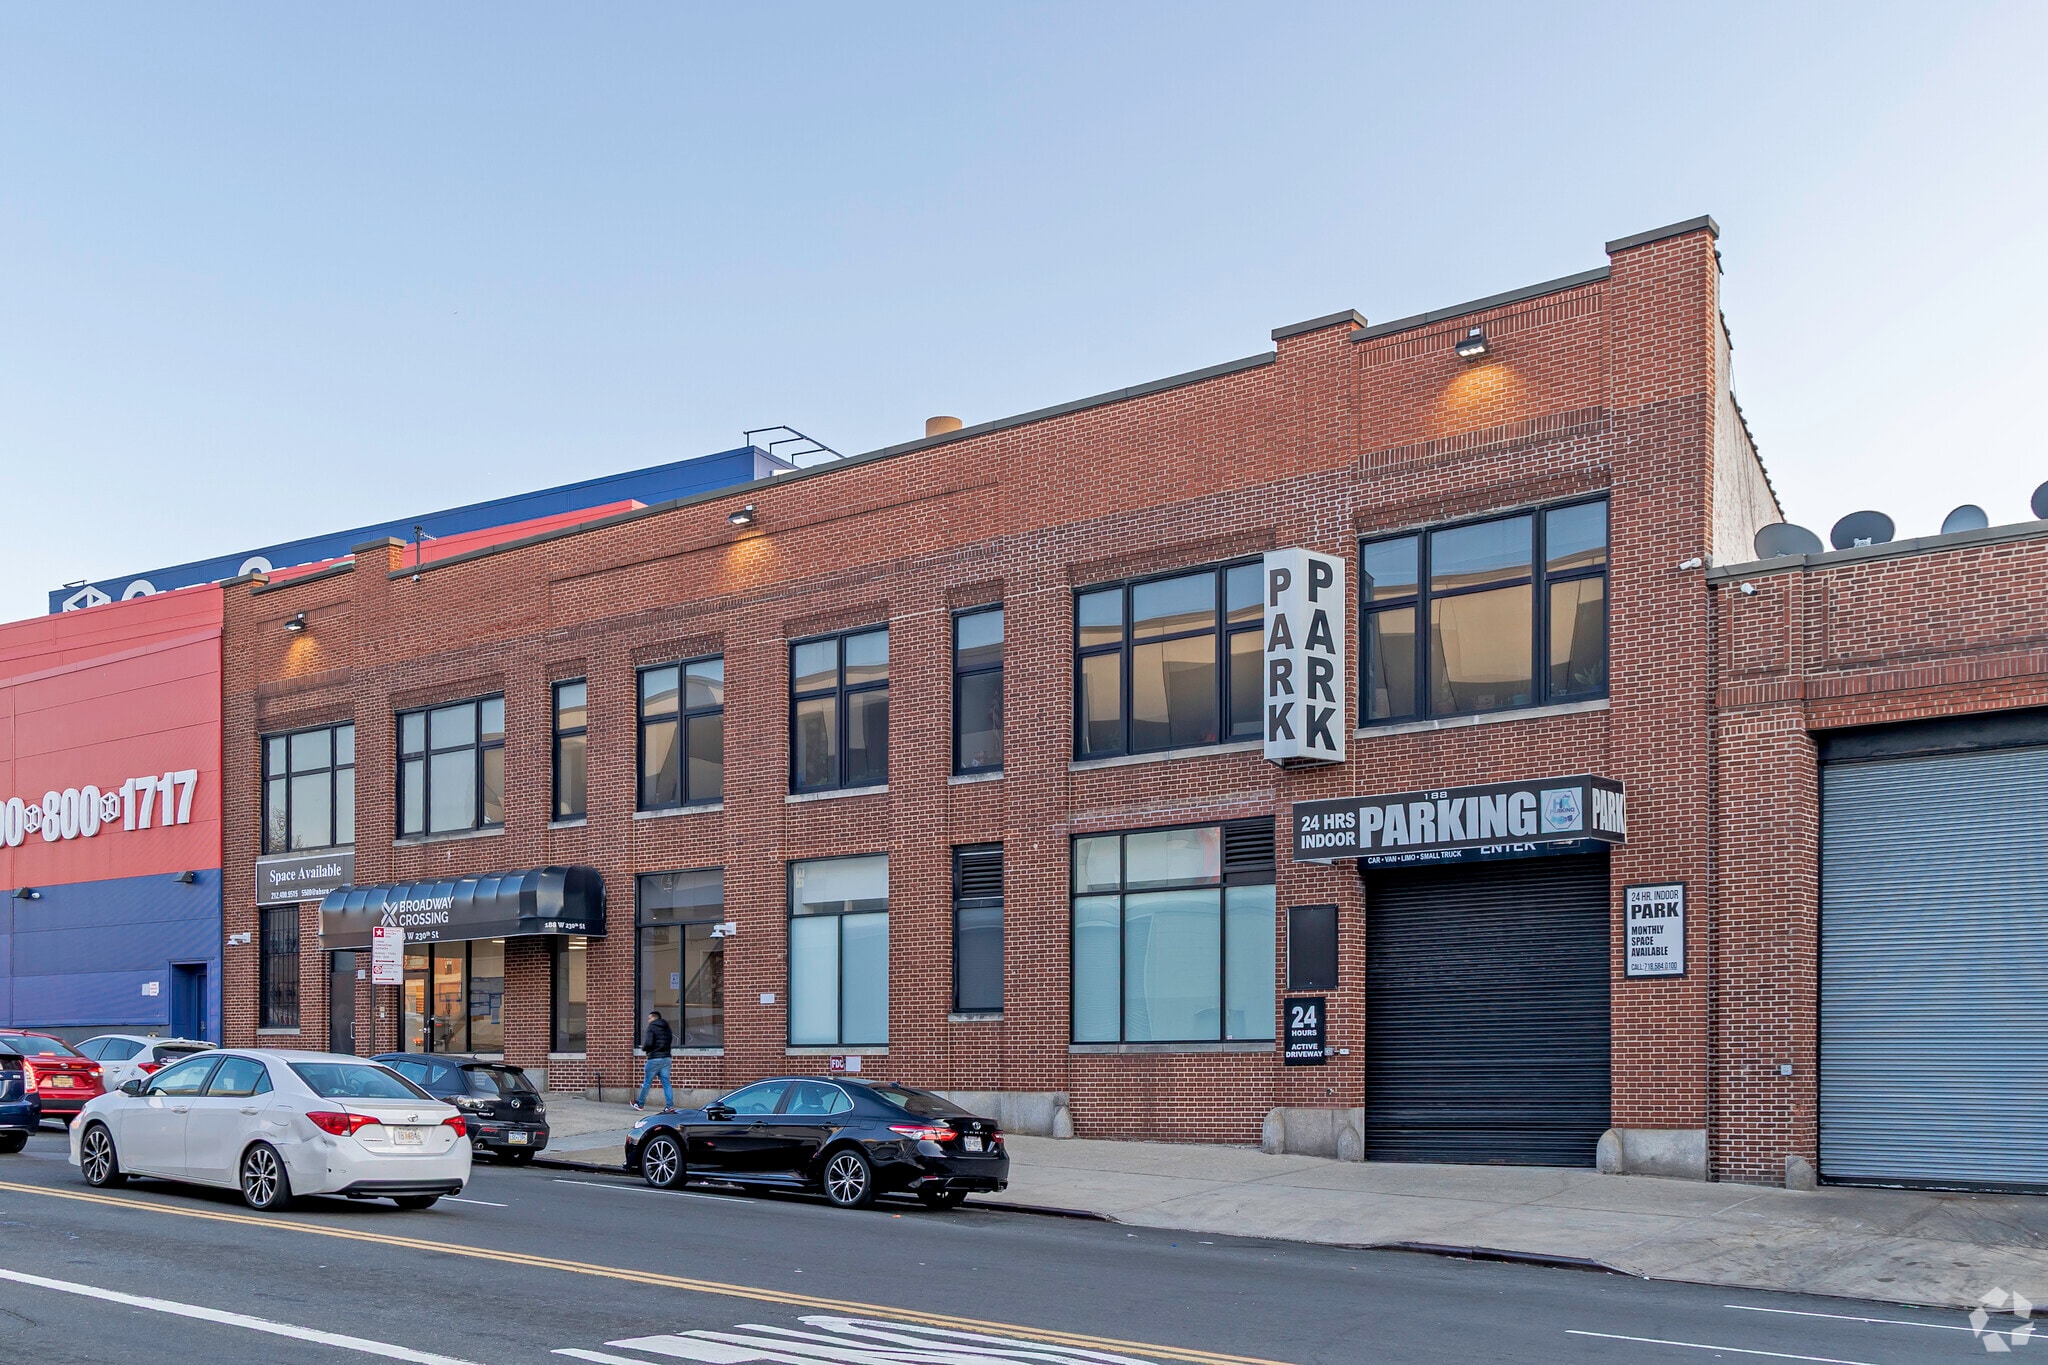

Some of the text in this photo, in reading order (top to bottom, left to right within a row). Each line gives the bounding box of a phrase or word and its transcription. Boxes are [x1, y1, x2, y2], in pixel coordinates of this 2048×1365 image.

[1267, 567, 1296, 742] PARK
[1305, 559, 1337, 751] PARK
[119, 769, 198, 831] 1717
[1423, 791, 1448, 800] 188
[1301, 812, 1356, 832] 24 HRS
[1359, 791, 1537, 849] PARKING
[1301, 831, 1356, 849] INDOOR
[1368, 856, 1381, 864] CAR
[1420, 852, 1440, 860] SMALL
[1441, 850, 1462, 858] TRUCK
[269, 863, 342, 886] Space Available
[1631, 892, 1640, 902] 24
[1653, 889, 1679, 900] INDOOR
[400, 896, 455, 912] BROADWAY
[1631, 902, 1679, 919] PARK
[399, 911, 449, 926] CROSSING
[407, 932, 415, 940] W
[431, 930, 439, 939] St
[1631, 925, 1664, 935] MONTHLY
[1632, 936, 1653, 946] SPACE
[1631, 946, 1668, 957] AVAILABLE
[1291, 1005, 1317, 1028] 24
[1285, 1050, 1323, 1058] DRIVEWAY
